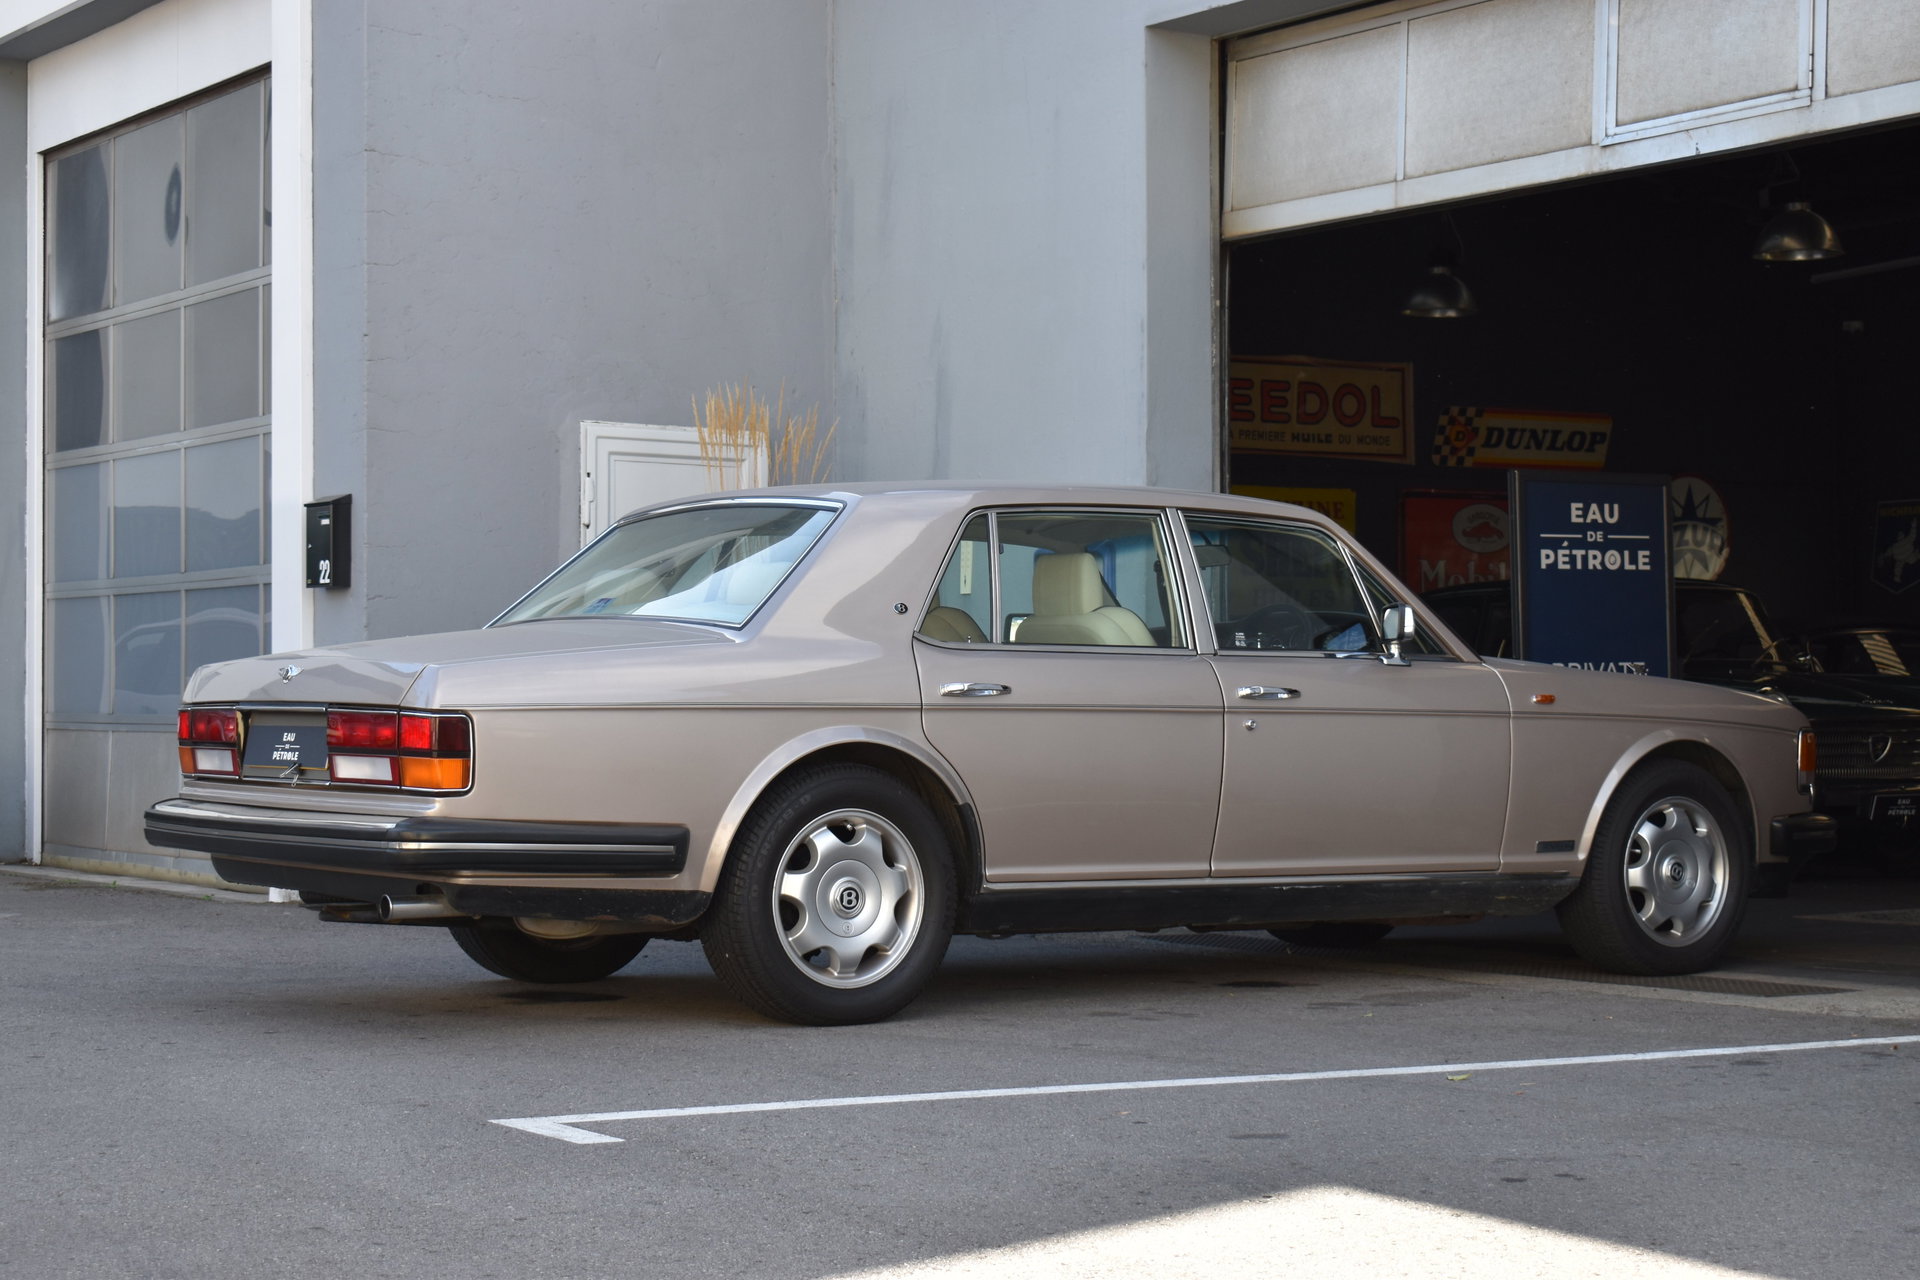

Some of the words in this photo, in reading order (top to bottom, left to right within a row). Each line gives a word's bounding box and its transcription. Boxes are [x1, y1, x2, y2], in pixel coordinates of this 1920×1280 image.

[1291, 432, 1333, 444] HUILE
[1338, 434, 1351, 445] DU
[1357, 435, 1391, 446] MONDE
[1481, 427, 1607, 452] DUNLOP
[1570, 502, 1619, 524] EAU
[1586, 531, 1604, 542] DE
[1540, 540, 1651, 571] PÉTROLE
[319, 559, 331, 584] 22
[283, 732, 296, 742] EAU
[272, 748, 299, 761] PÉTROLE
[842, 890, 857, 907] B
